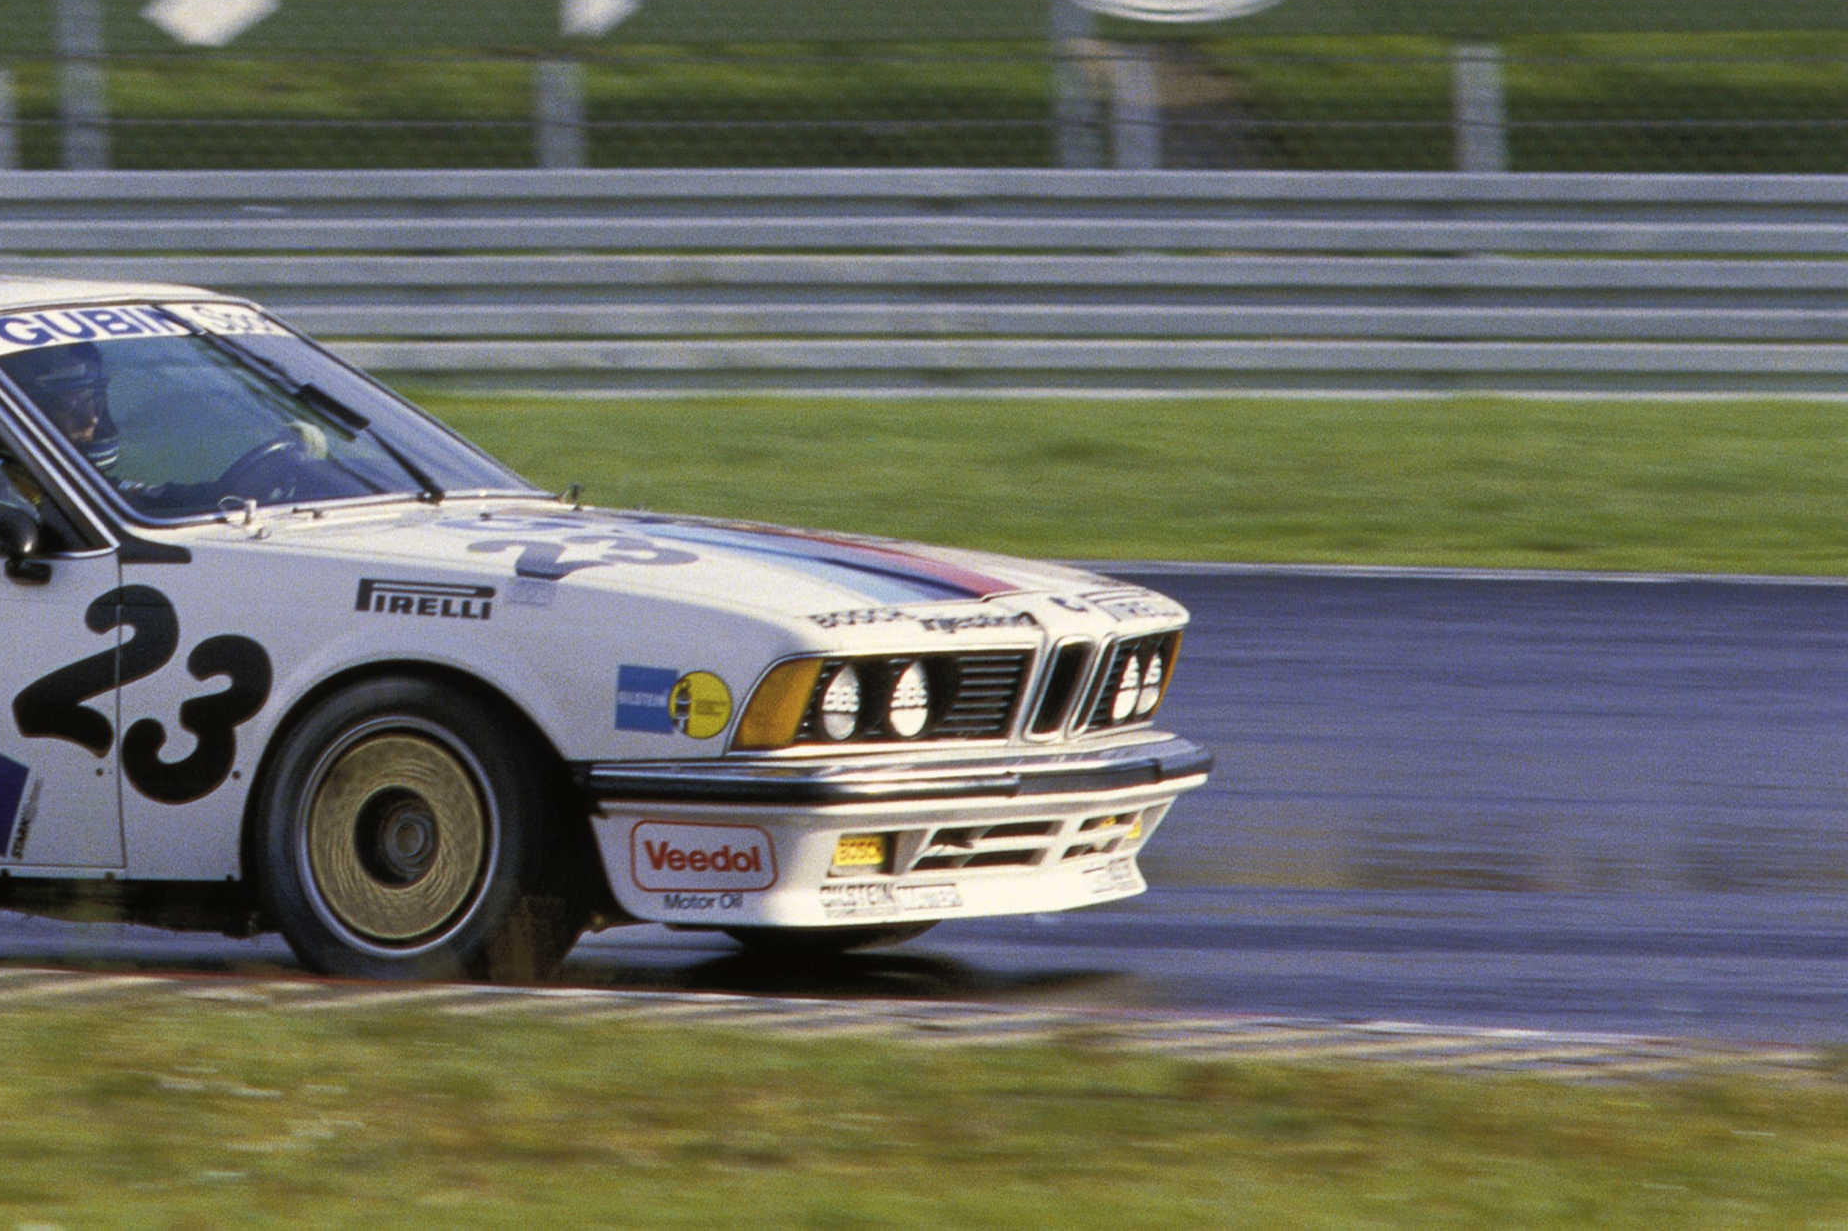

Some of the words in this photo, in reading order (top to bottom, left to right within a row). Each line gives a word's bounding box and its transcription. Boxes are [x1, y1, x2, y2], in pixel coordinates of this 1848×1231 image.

[355, 577, 499, 621] PIRELLI
[12, 584, 273, 805] 23
[644, 839, 762, 873] Veedol
[663, 893, 715, 909] Motor
[719, 893, 744, 909] Oil
